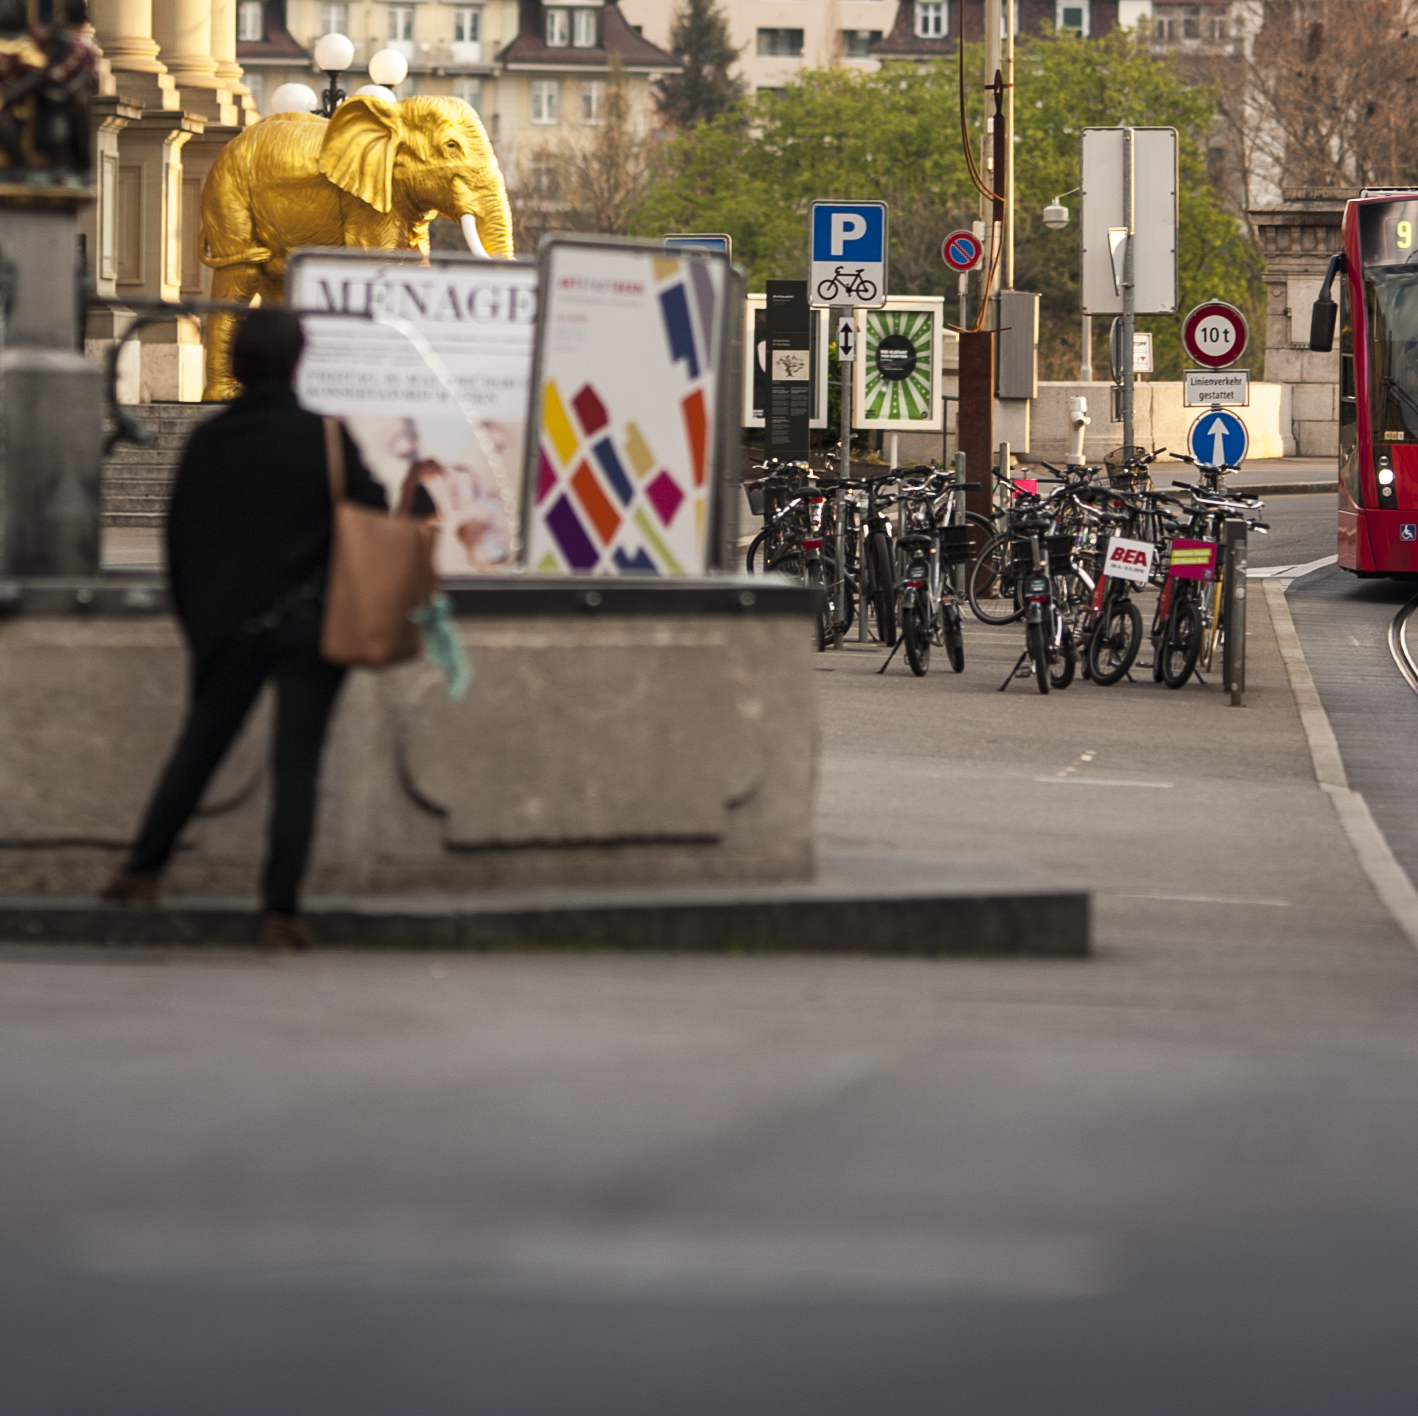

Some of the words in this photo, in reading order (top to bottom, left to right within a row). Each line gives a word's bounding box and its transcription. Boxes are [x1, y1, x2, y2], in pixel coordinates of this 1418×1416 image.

[830, 213, 867, 256] P
[1397, 220, 1412, 249] 9
[1201, 327, 1219, 343] 10
[1222, 328, 1230, 343] t
[1190, 377, 1242, 386] Linienverkehr
[1199, 391, 1234, 401] gestattet
[1110, 547, 1147, 567] BEA
